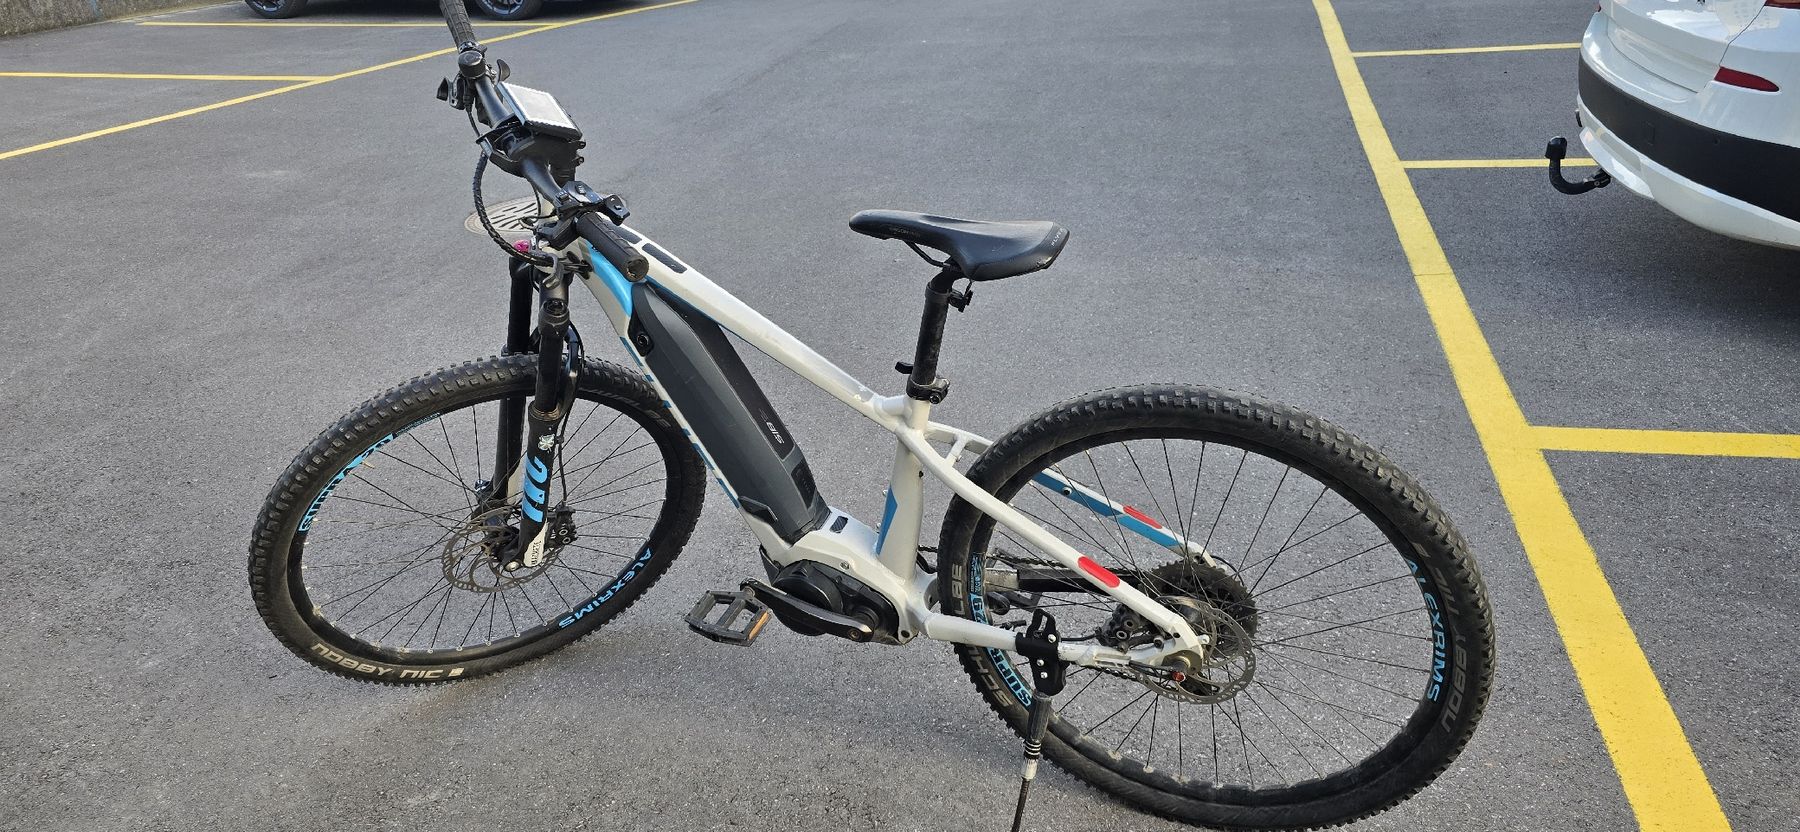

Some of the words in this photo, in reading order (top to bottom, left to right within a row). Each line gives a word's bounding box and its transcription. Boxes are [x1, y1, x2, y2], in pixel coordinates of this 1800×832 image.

[558, 548, 652, 629] ALEXRIMS
[311, 643, 393, 677] NOBBY
[400, 668, 444, 680] NIC
[951, 563, 1013, 708] SCHLBE
[987, 646, 1031, 706] SUPR
